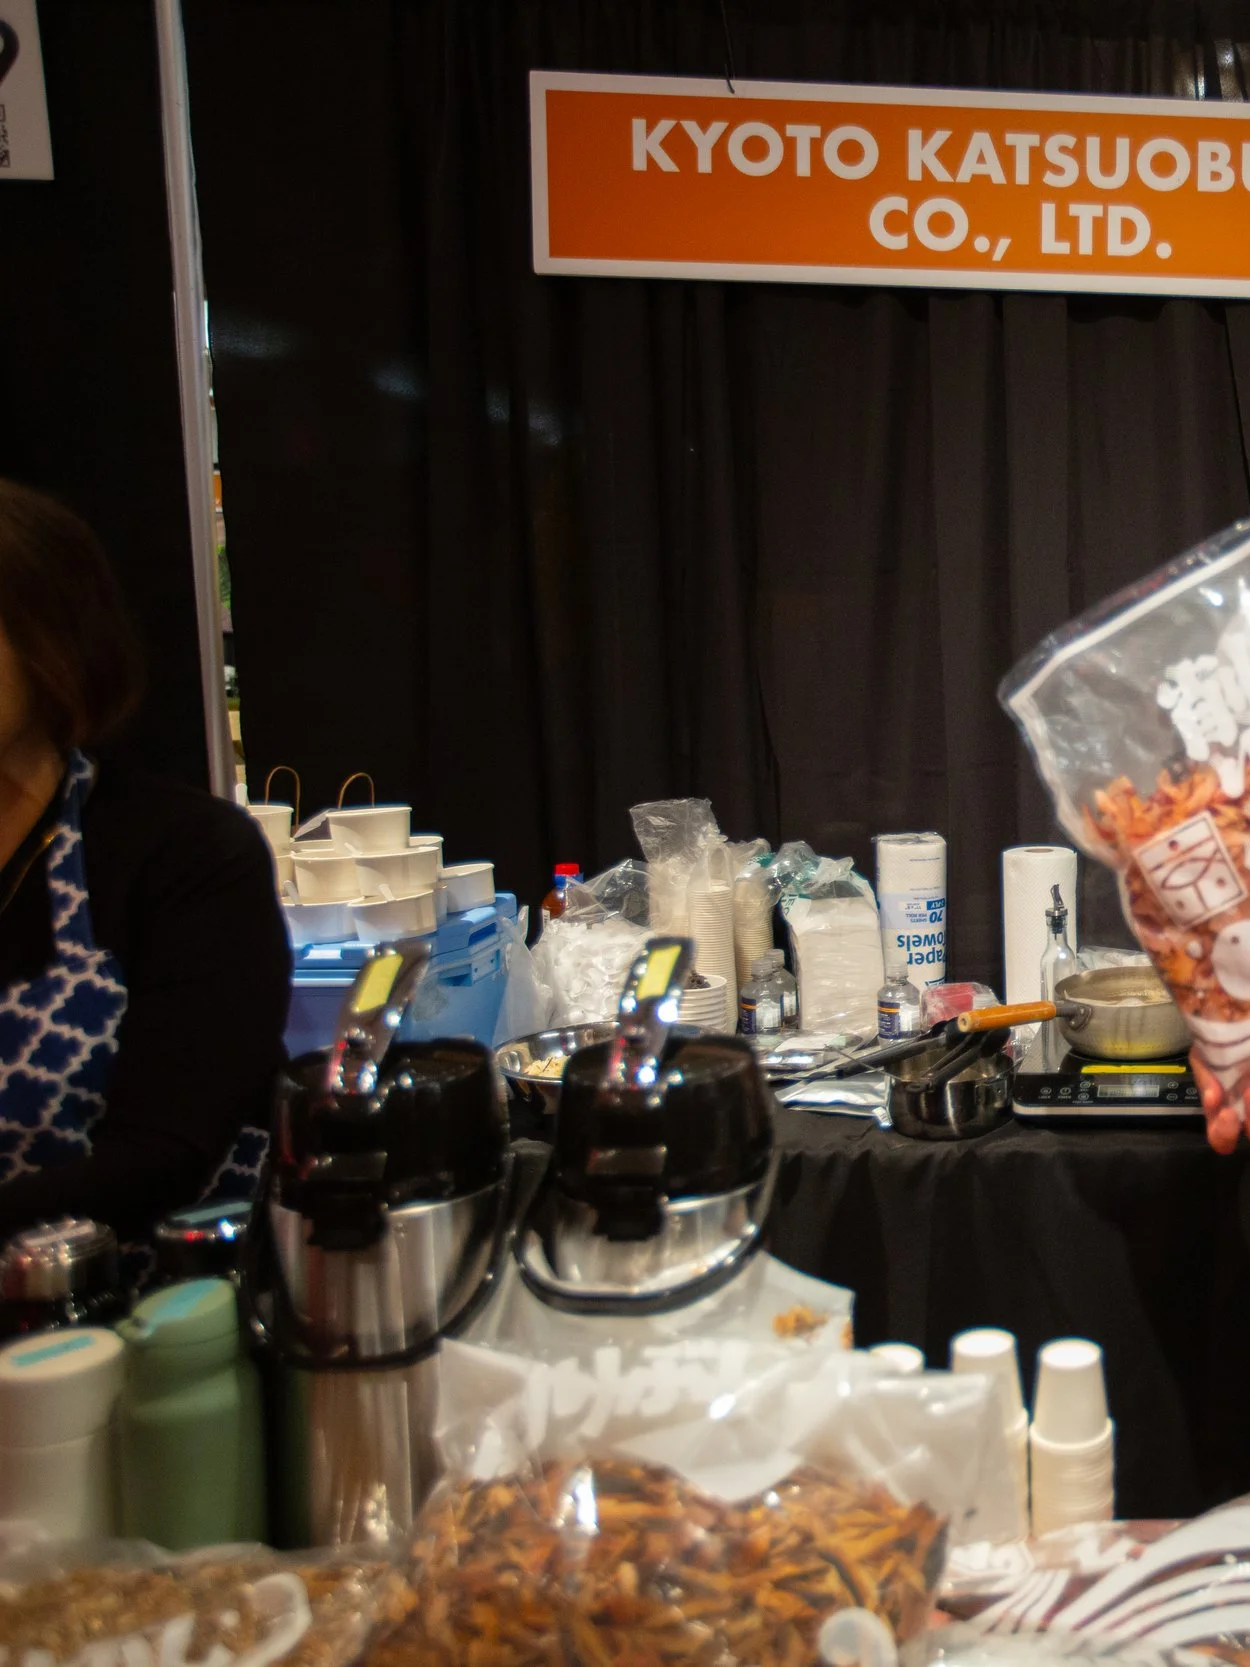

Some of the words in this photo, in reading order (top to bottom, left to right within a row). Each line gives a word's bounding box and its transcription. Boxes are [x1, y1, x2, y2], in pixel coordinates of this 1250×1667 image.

[632, 118, 879, 180] KYOTO
[868, 195, 1011, 261] CO.,
[1041, 201, 1172, 260] LTD.
[929, 911, 943, 924] 70
